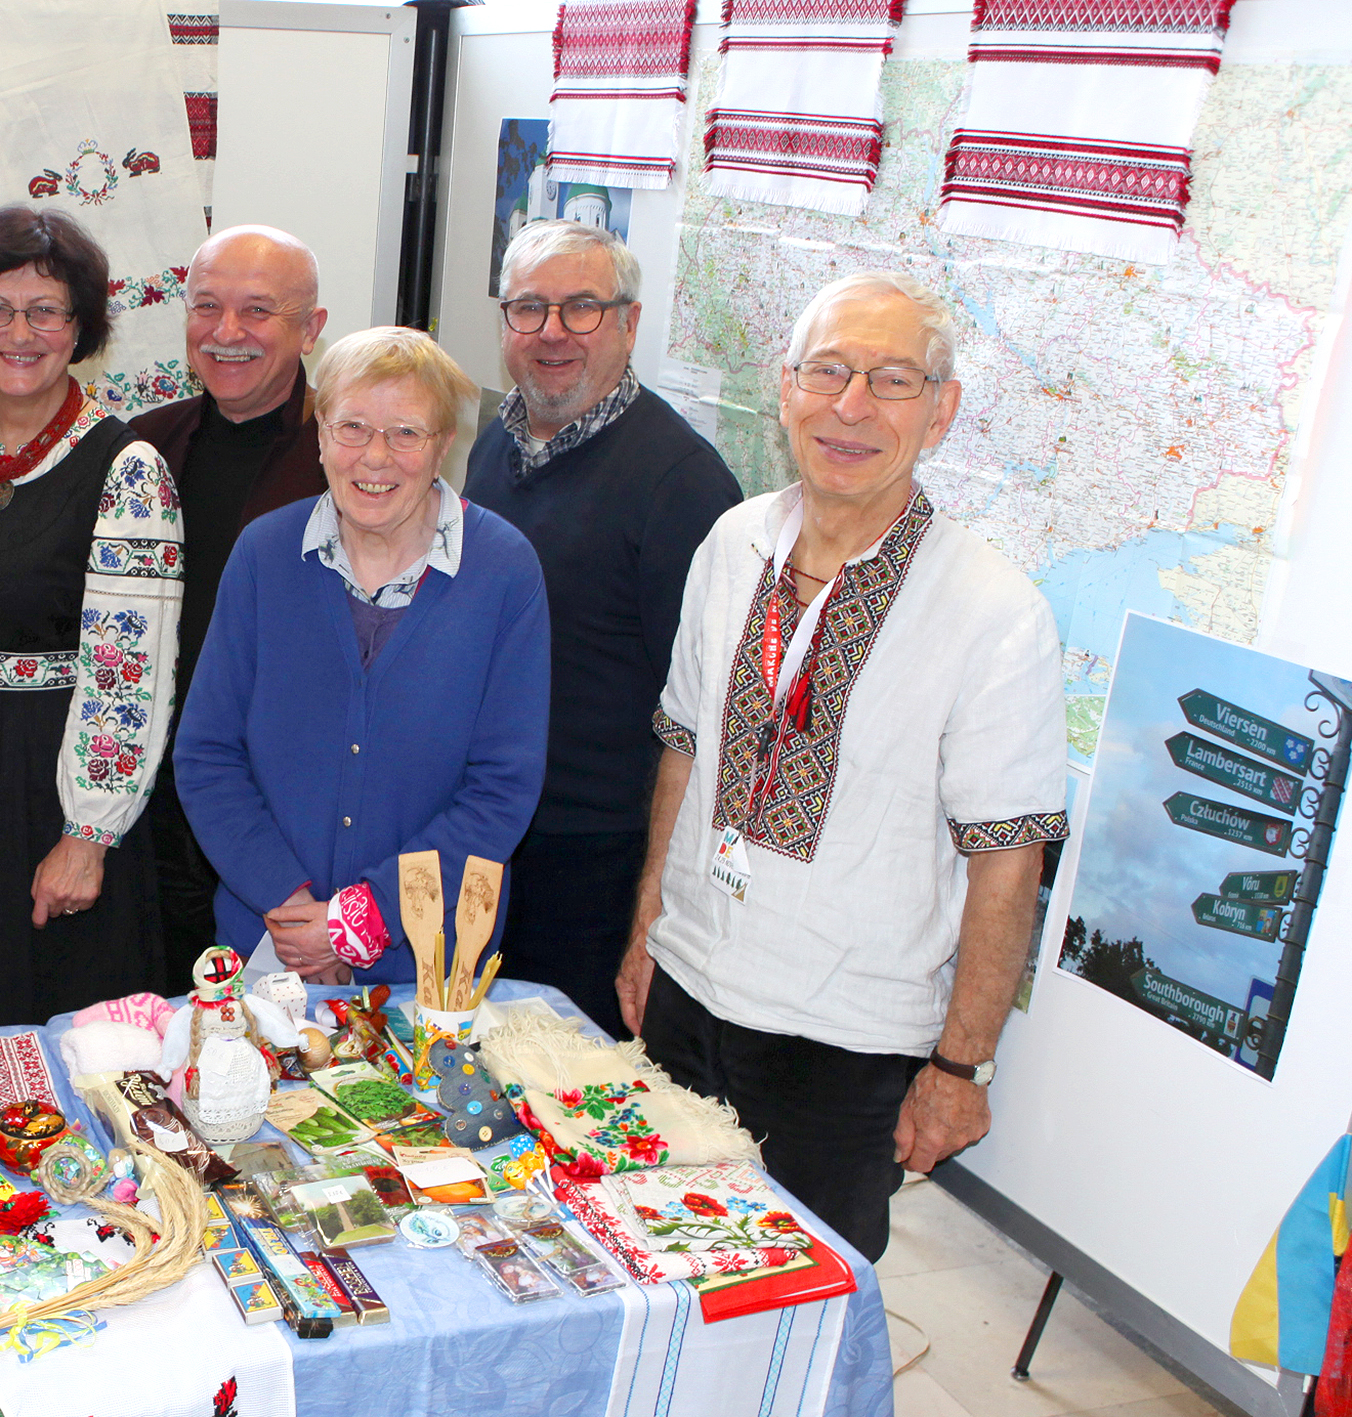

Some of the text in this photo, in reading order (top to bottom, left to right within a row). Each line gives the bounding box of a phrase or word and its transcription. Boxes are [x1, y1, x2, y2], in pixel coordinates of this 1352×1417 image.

[1199, 715, 1236, 737] Deutschland
[1217, 703, 1268, 740] Viersen
[1185, 757, 1205, 771] France
[1187, 740, 1267, 787] Lambersart
[1181, 814, 1198, 825] Polska
[1190, 801, 1250, 831] Człuchów
[1213, 900, 1246, 923] Kobryn
[1143, 973, 1224, 1023] Southborough
[1147, 992, 1160, 1003] Great
[1161, 999, 1178, 1011] Britain
